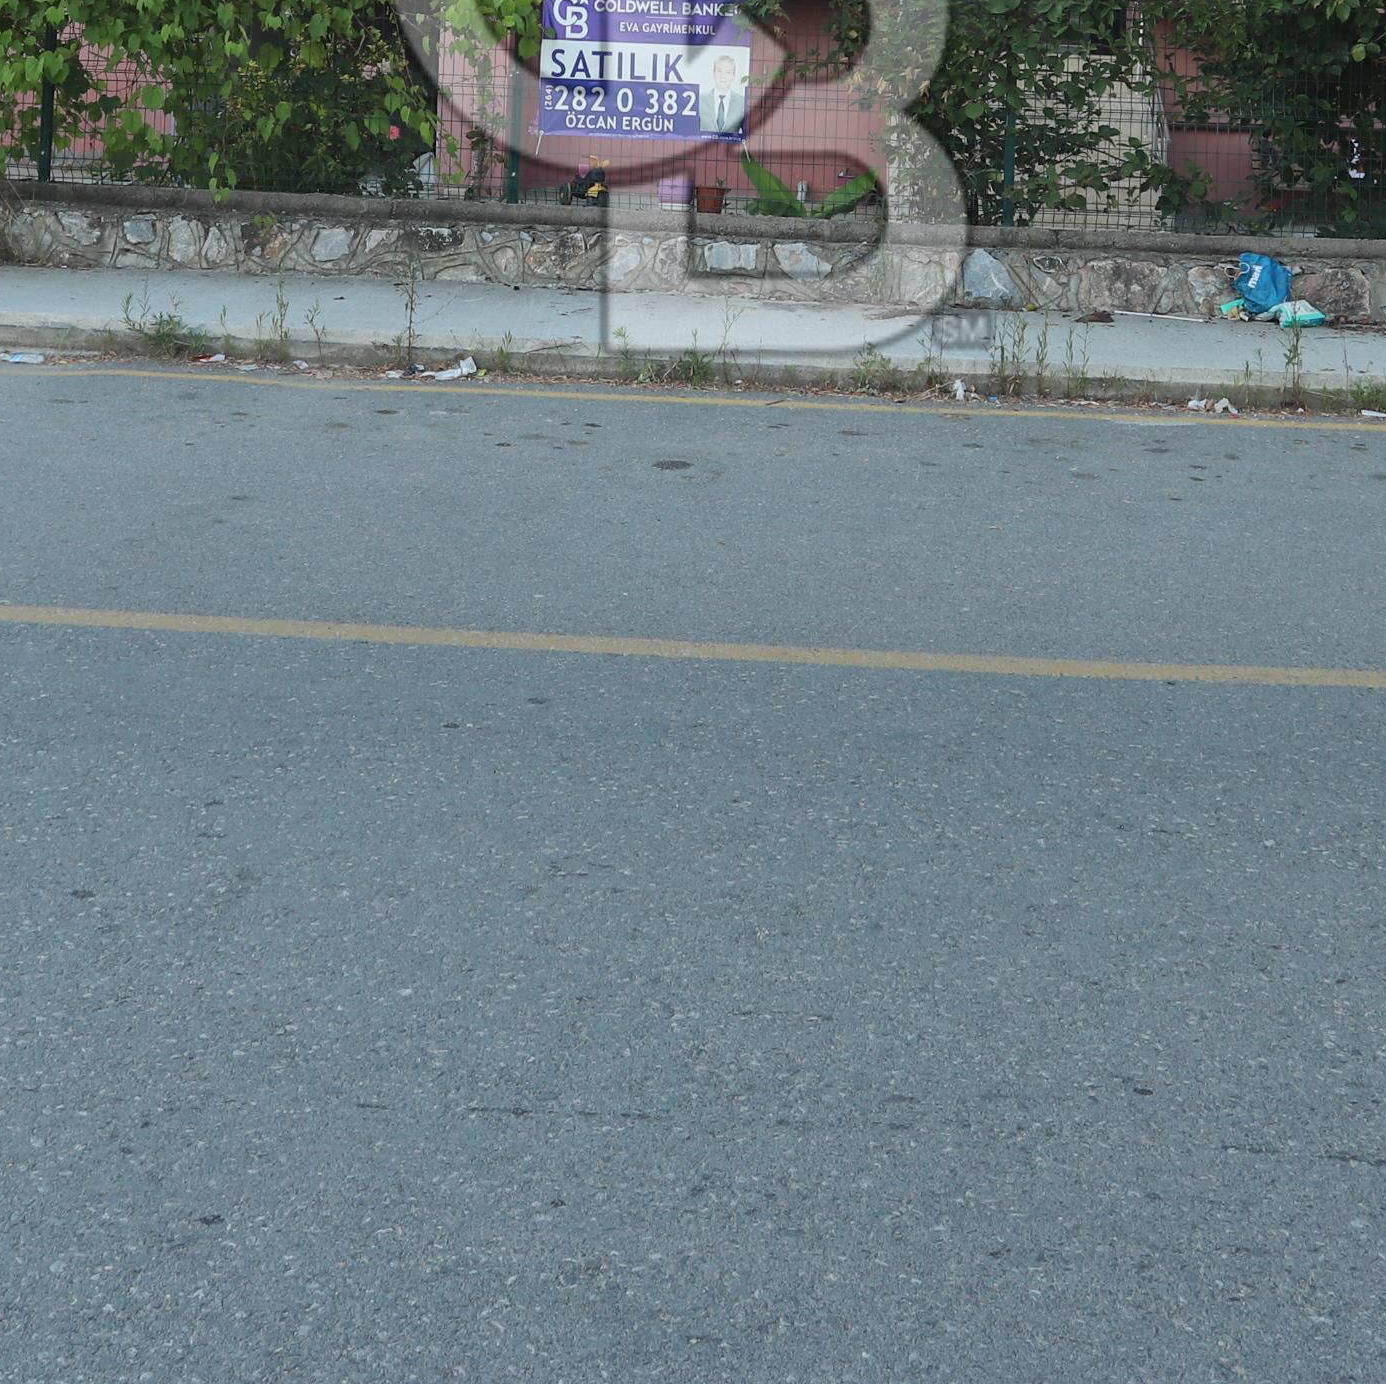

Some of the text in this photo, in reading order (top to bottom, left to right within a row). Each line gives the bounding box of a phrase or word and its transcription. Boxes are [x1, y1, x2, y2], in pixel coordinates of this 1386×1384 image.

[594, 0, 677, 15] COLDWELL
[619, 21, 716, 36] EVA GAYRİMENKUL
[551, 48, 685, 83] SATILIK
[544, 84, 554, 110] (264)
[554, 85, 697, 116] 282 0 382
[565, 112, 674, 132] ÖZCAN ERGÜN
